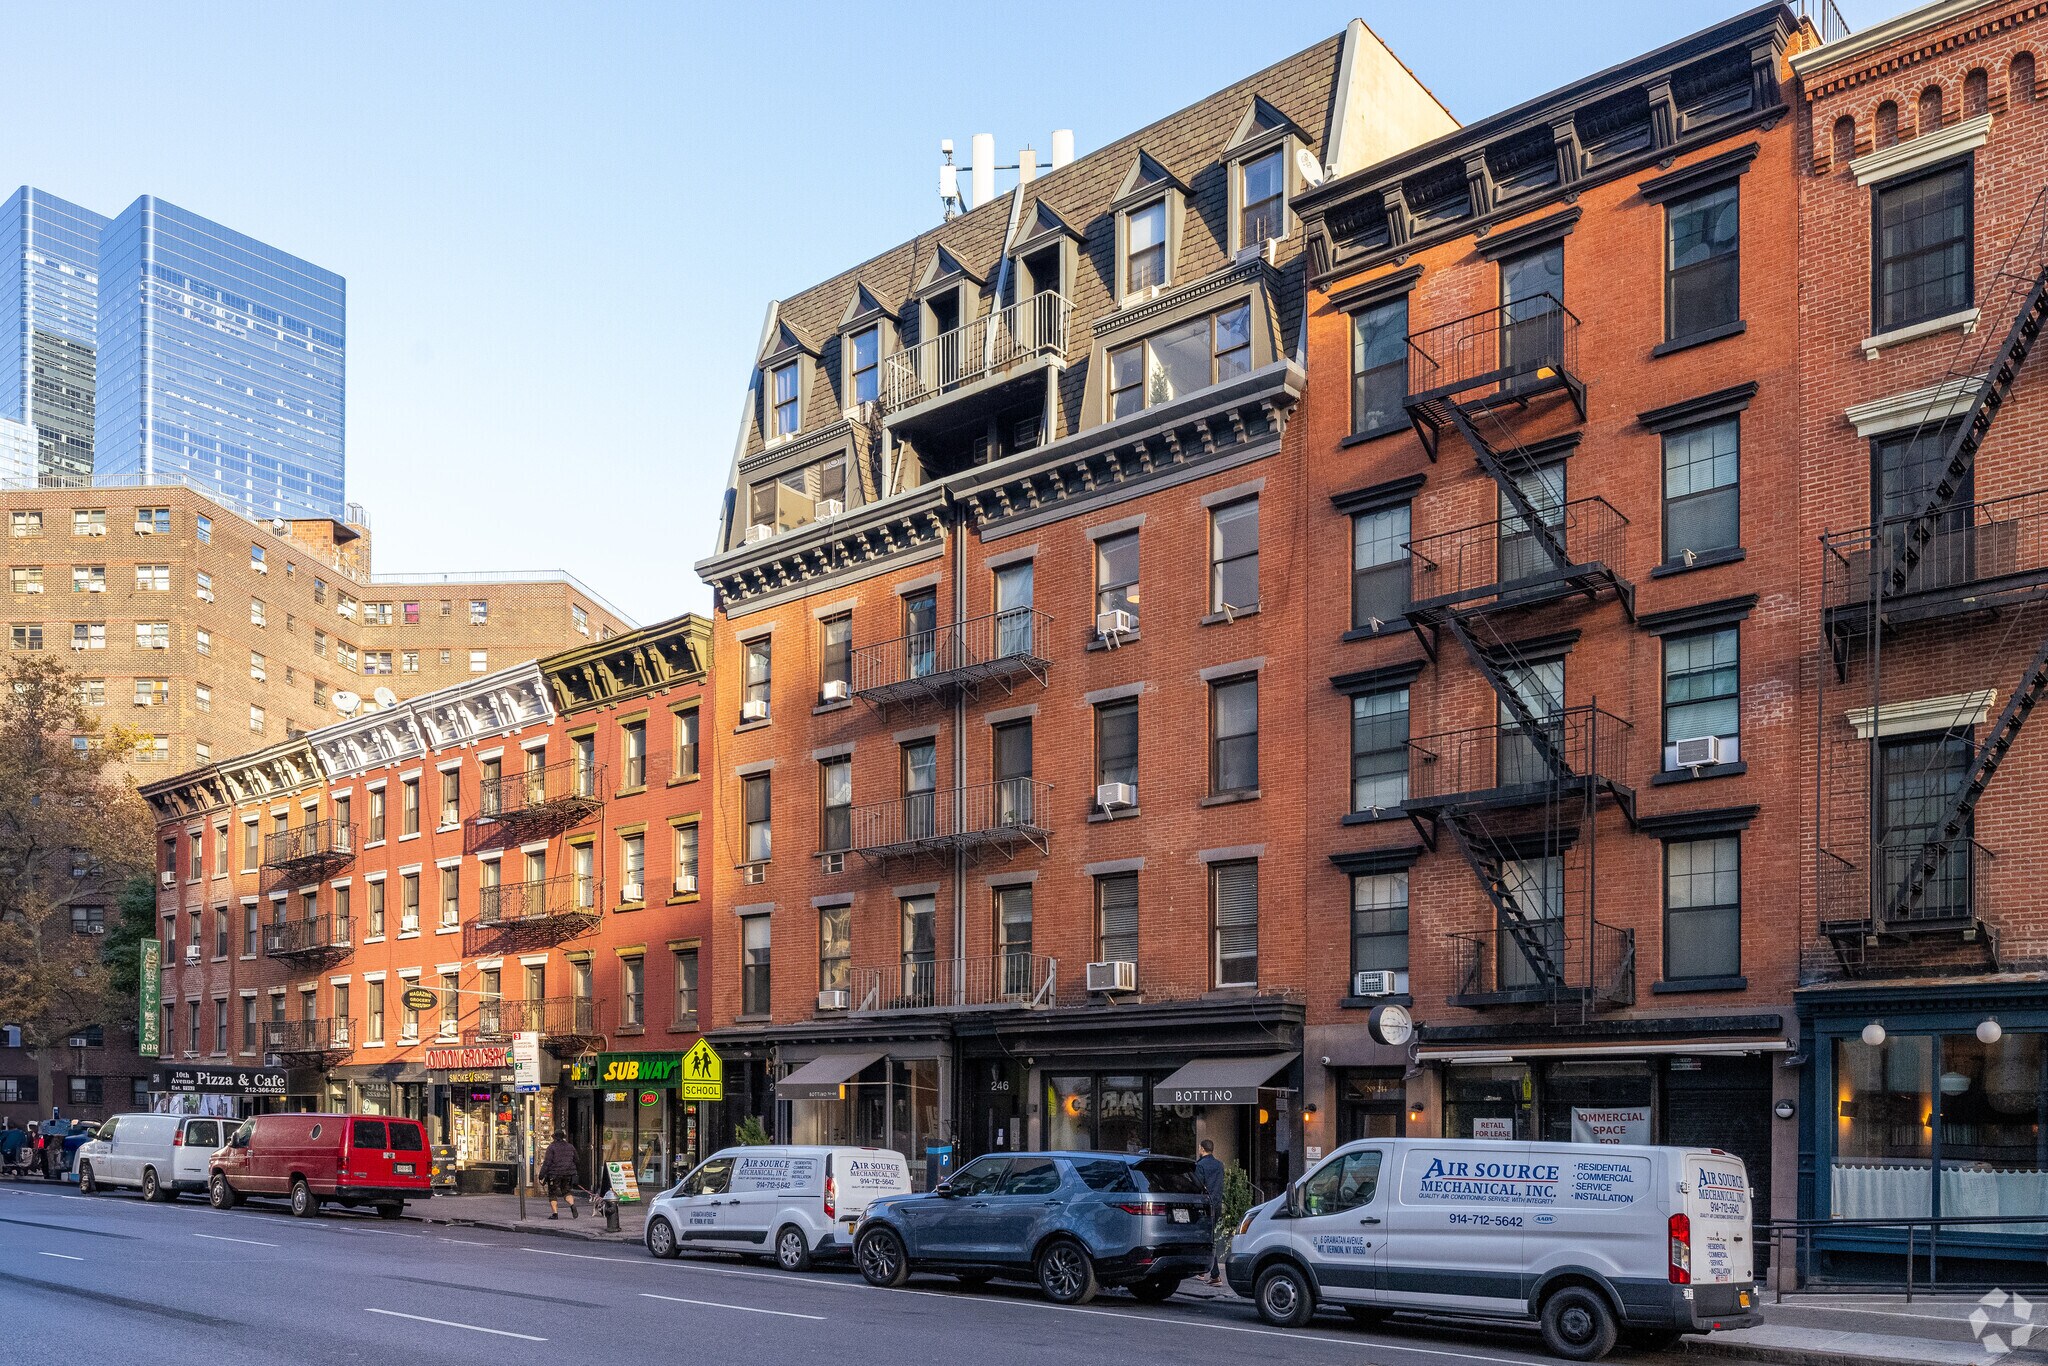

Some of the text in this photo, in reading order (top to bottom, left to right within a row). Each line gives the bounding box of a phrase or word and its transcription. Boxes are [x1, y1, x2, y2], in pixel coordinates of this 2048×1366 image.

[424, 1047, 507, 1069] LONDON GROCERY
[176, 1071, 190, 1079] 10th
[603, 1060, 679, 1081] SUBWAY
[171, 1077, 195, 1085] Avenue
[196, 1071, 285, 1087] Pizza & Cafe
[448, 1073, 470, 1082] SMOKE
[473, 1073, 489, 1082] SHOP
[685, 1086, 719, 1095] SCHOOL
[991, 1081, 1009, 1091] 246
[641, 1094, 656, 1103] OPEN
[1480, 1121, 1505, 1129] RETAIL
[1592, 1125, 1627, 1135] SPACE
[1475, 1130, 1511, 1138] FOR LEASE
[741, 1158, 790, 1169] AIR SOURCE
[850, 1160, 900, 1171] AIR SOURCE
[1577, 1162, 1632, 1173] RESIDENTIAL
[1421, 1158, 1559, 1181] AIR SOURCE
[859, 1177, 895, 1185] 914-712-5642
[1576, 1172, 1635, 1183] COMMERCIAL
[1698, 1167, 1744, 1189] AIR SOURCE
[756, 1181, 791, 1189] 914-712-5642
[1420, 1180, 1557, 1198] MECHANICAL, INC.
[1575, 1182, 1612, 1191] SERVICE
[1574, 1192, 1634, 1203] INSTALLATION
[1710, 1201, 1740, 1214] 914-712-5642
[1449, 1213, 1523, 1227] 914-712-5642
[1346, 1236, 1363, 1245] AVENUE
[1317, 1244, 1326, 1253] MT.
[1345, 1246, 1351, 1254] NY
[1352, 1246, 1366, 1255] 10550
